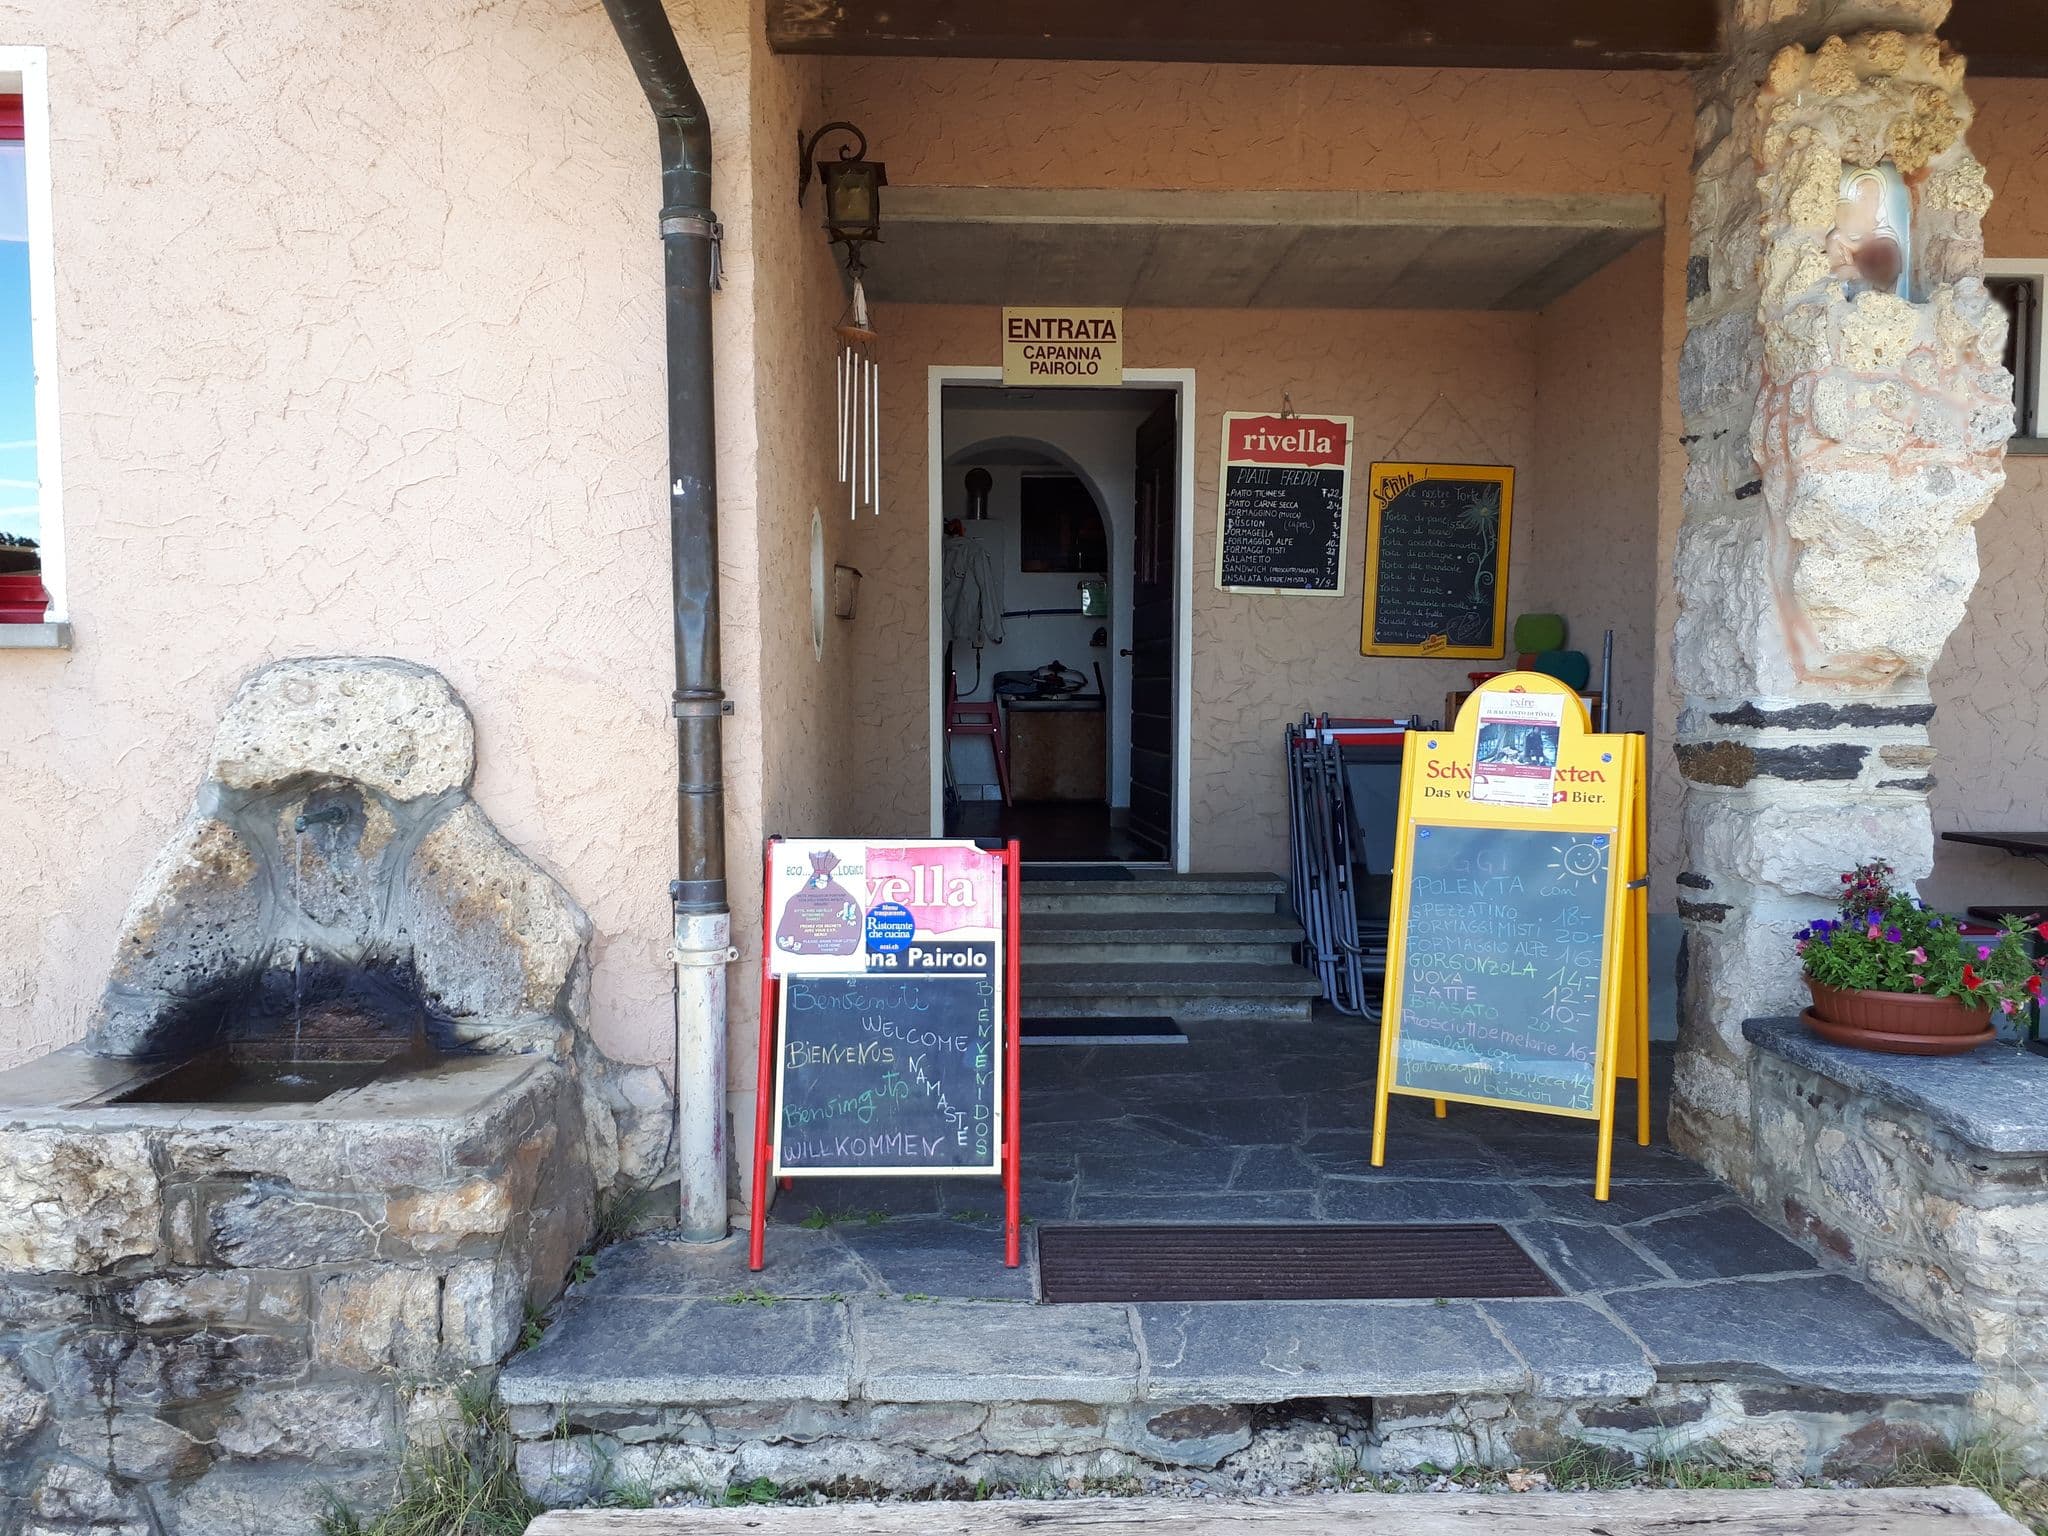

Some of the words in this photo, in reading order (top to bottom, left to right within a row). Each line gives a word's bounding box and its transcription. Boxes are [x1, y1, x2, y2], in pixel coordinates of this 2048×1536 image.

[1008, 318, 1117, 340] ENTRATA
[1023, 345, 1102, 360] CAPANNA
[1030, 361, 1099, 375] PAIROLO
[1242, 427, 1333, 454] rivella
[1237, 468, 1271, 485] PIATTI
[1280, 470, 1320, 487] FREDDI
[1230, 490, 1252, 498] PIATTO
[1254, 490, 1286, 498] TICINESE
[1229, 500, 1250, 508] PIATTO
[1253, 500, 1278, 508] CARNE
[1279, 501, 1299, 509] SECCA
[1228, 509, 1277, 518] FORMAGGINO
[1278, 511, 1301, 520] (MUCCA)
[1225, 528, 1274, 538] FORMAGELLA
[1226, 546, 1263, 554] FORMAGGI
[1266, 546, 1286, 554] MISTI
[1228, 538, 1271, 546] FORMAGGIO
[1275, 538, 1294, 546] ALPE
[1225, 555, 1271, 564] SALAMETTO
[1225, 564, 1267, 573] SANDWICH
[1223, 574, 1262, 583] INSALATA
[1424, 786, 1451, 798] Das
[1456, 789, 1471, 799] vo
[1572, 791, 1606, 803] Bier.
[865, 864, 977, 908] vella
[1411, 876, 1526, 897] POLENTA
[1411, 900, 1518, 921] SPEZZATINO
[866, 916, 914, 930] Ristorante
[1406, 917, 1495, 935] FORMAGGI
[868, 929, 883, 938] che
[884, 930, 911, 938] cucina
[1406, 935, 1508, 954] FORMAGGIO
[1514, 940, 1550, 958] ALPE
[908, 947, 987, 967] Pairolo
[1408, 952, 1538, 979] GORGONZOLA
[1412, 969, 1464, 985] UOVA
[1411, 985, 1479, 1001] LATTE
[1408, 993, 1500, 1019] BRASATO
[861, 1015, 969, 1052] WELCOME
[1500, 1028, 1558, 1057] melone
[1510, 1067, 1568, 1091] mucca
[783, 1131, 946, 1162] WILLKOMMEN
